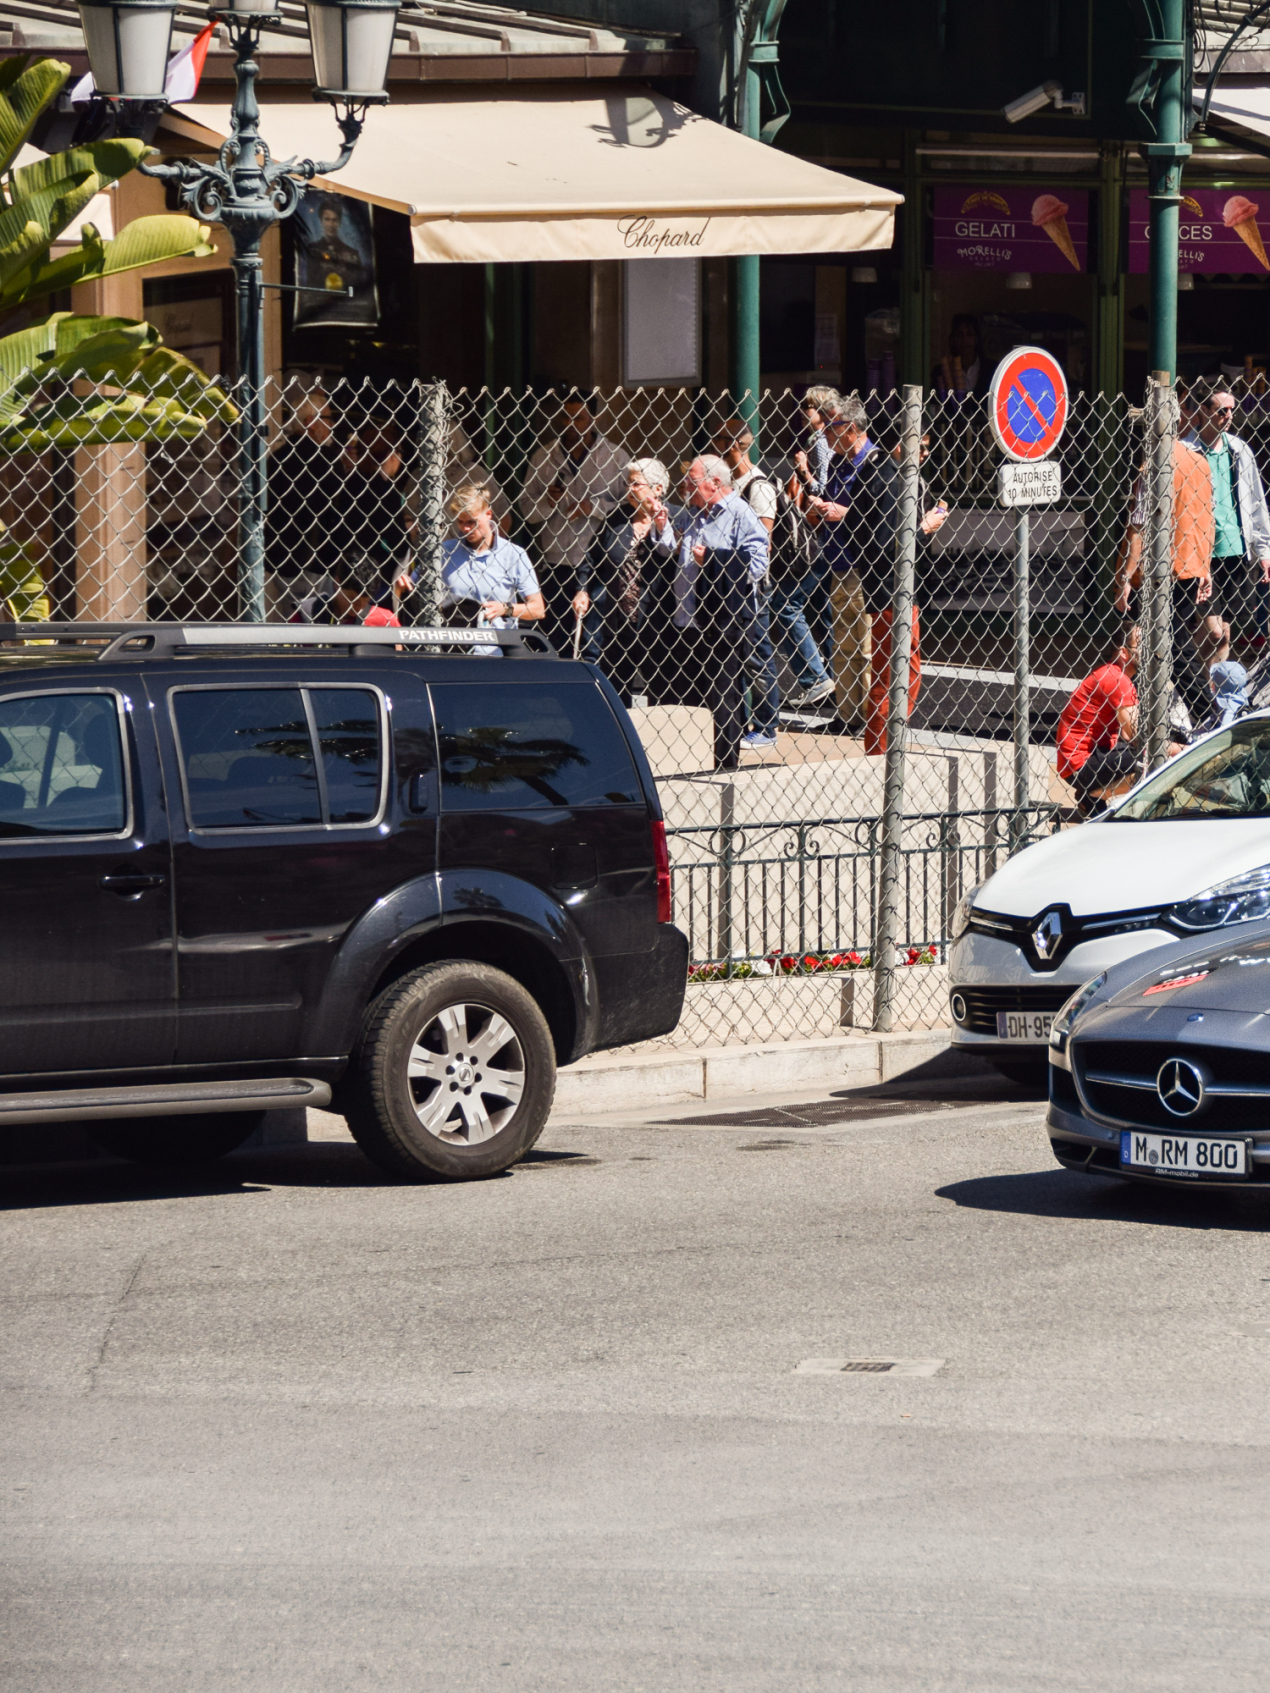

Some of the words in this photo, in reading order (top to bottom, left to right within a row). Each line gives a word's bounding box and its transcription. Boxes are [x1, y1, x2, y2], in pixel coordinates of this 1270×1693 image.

[617, 215, 712, 255] Chopard
[955, 221, 1016, 238] GELATI
[957, 245, 1012, 260] MORELLI'S
[1008, 488, 1017, 499] 10
[1021, 485, 1058, 498] MINUTES
[398, 630, 496, 641] PATHFINDER
[1009, 1016, 1055, 1038] DH-95
[1136, 1136, 1147, 1162] M
[1161, 1139, 1188, 1166] RM
[1196, 1142, 1238, 1169] 800
